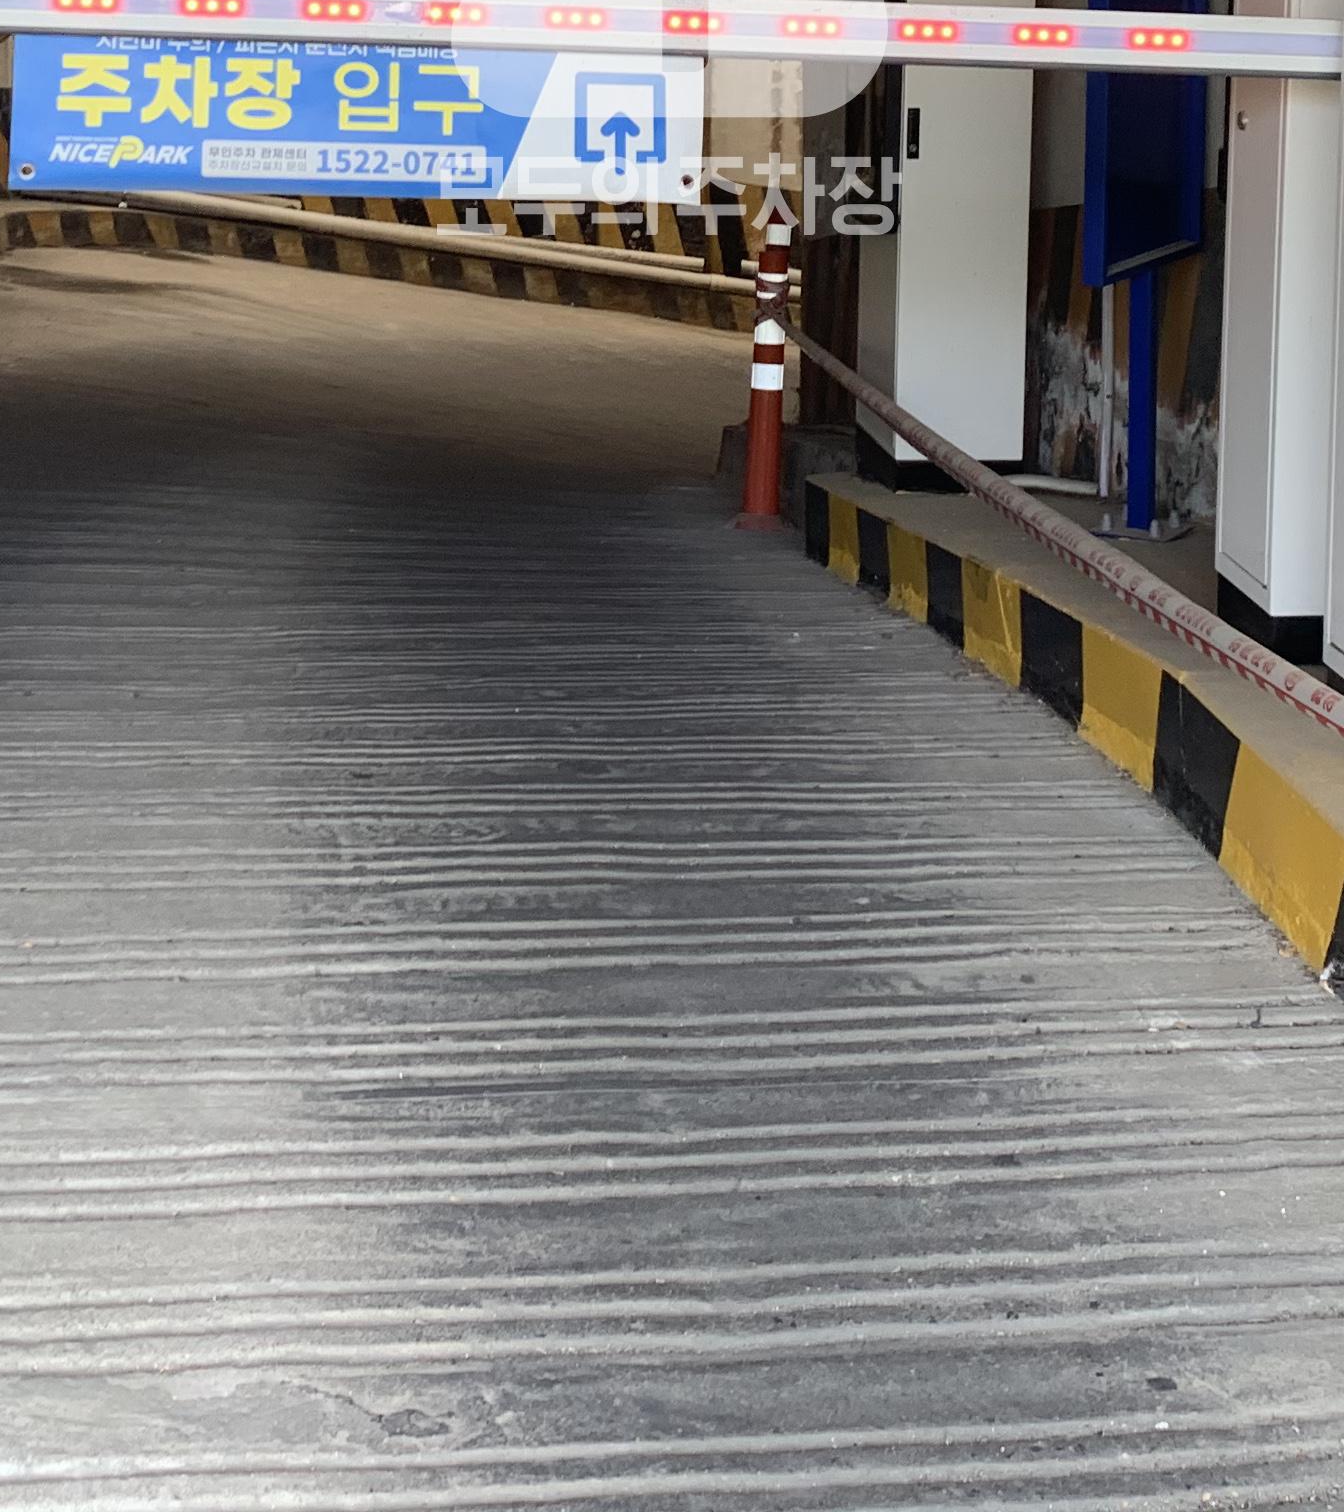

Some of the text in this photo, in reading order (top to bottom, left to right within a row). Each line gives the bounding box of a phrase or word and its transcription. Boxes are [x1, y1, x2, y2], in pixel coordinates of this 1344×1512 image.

[57, 53, 484, 136] 주차장 입구
[48, 135, 194, 168] NICEPARK
[316, 149, 477, 176] 1522-0741
